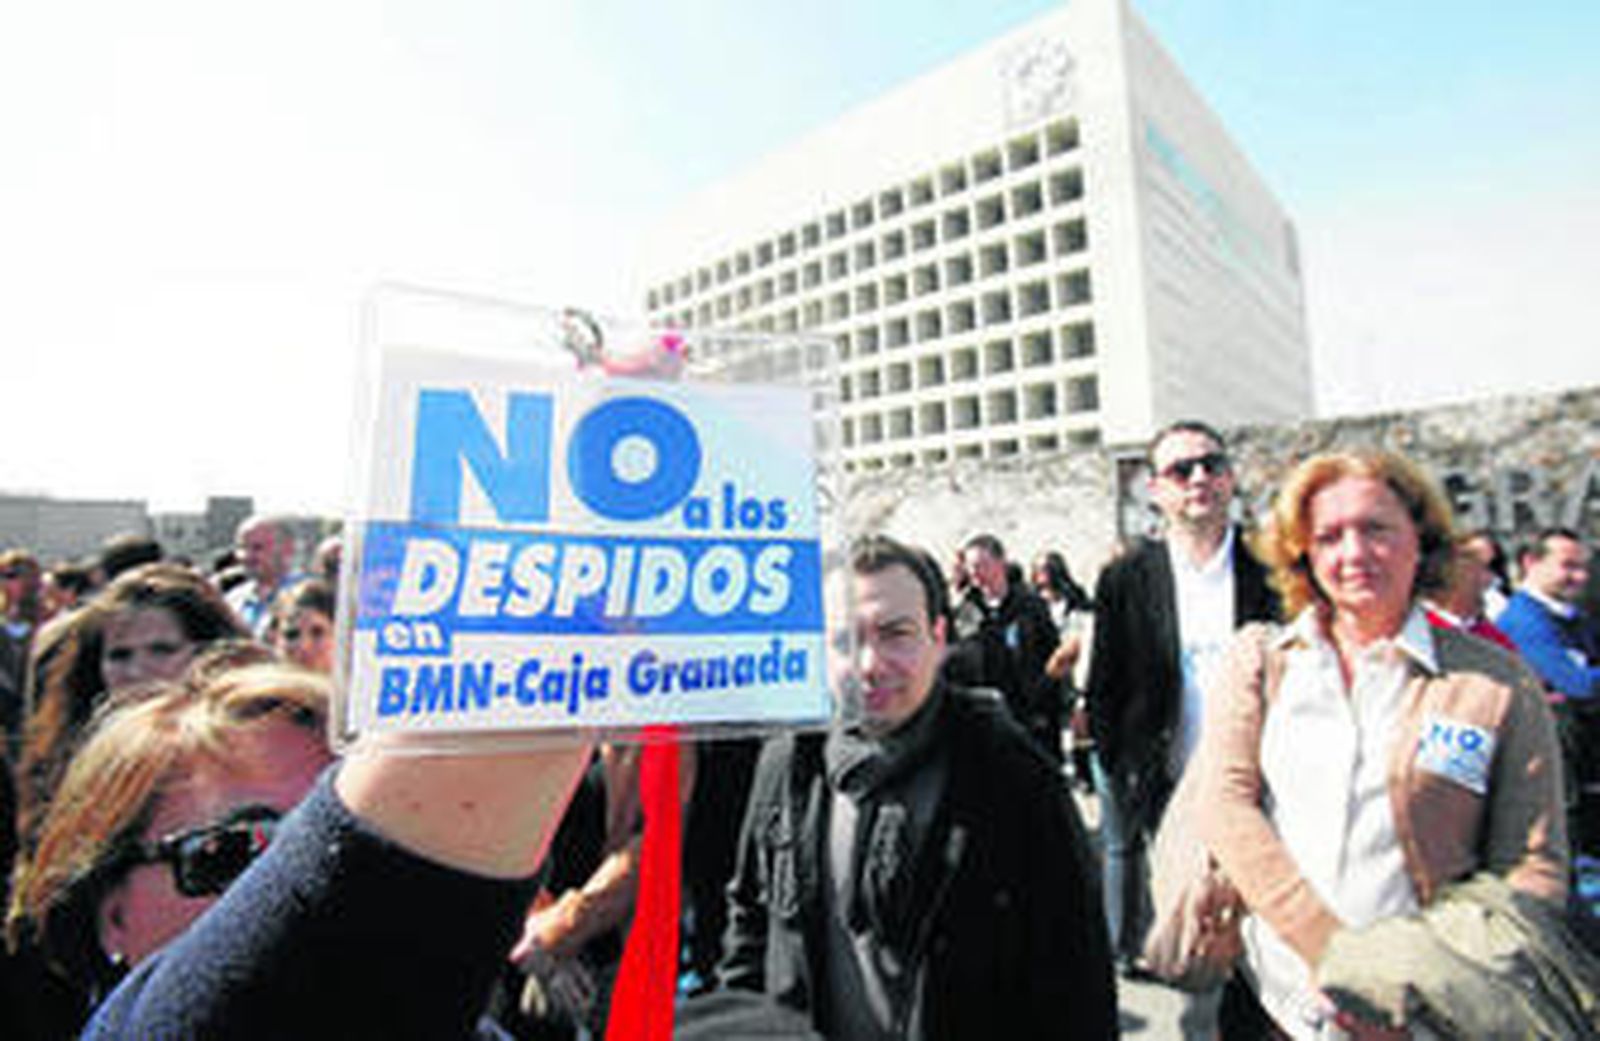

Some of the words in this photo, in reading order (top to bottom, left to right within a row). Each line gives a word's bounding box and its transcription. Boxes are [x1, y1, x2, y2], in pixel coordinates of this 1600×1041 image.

[411, 389, 701, 523] NO
[682, 499, 711, 530] a
[722, 482, 788, 530] los
[392, 538, 794, 617] DESPIDOS
[383, 621, 443, 650] en
[376, 653, 611, 716] BMN-Caja
[627, 638, 808, 697] Granada
[1426, 723, 1484, 752] NO
